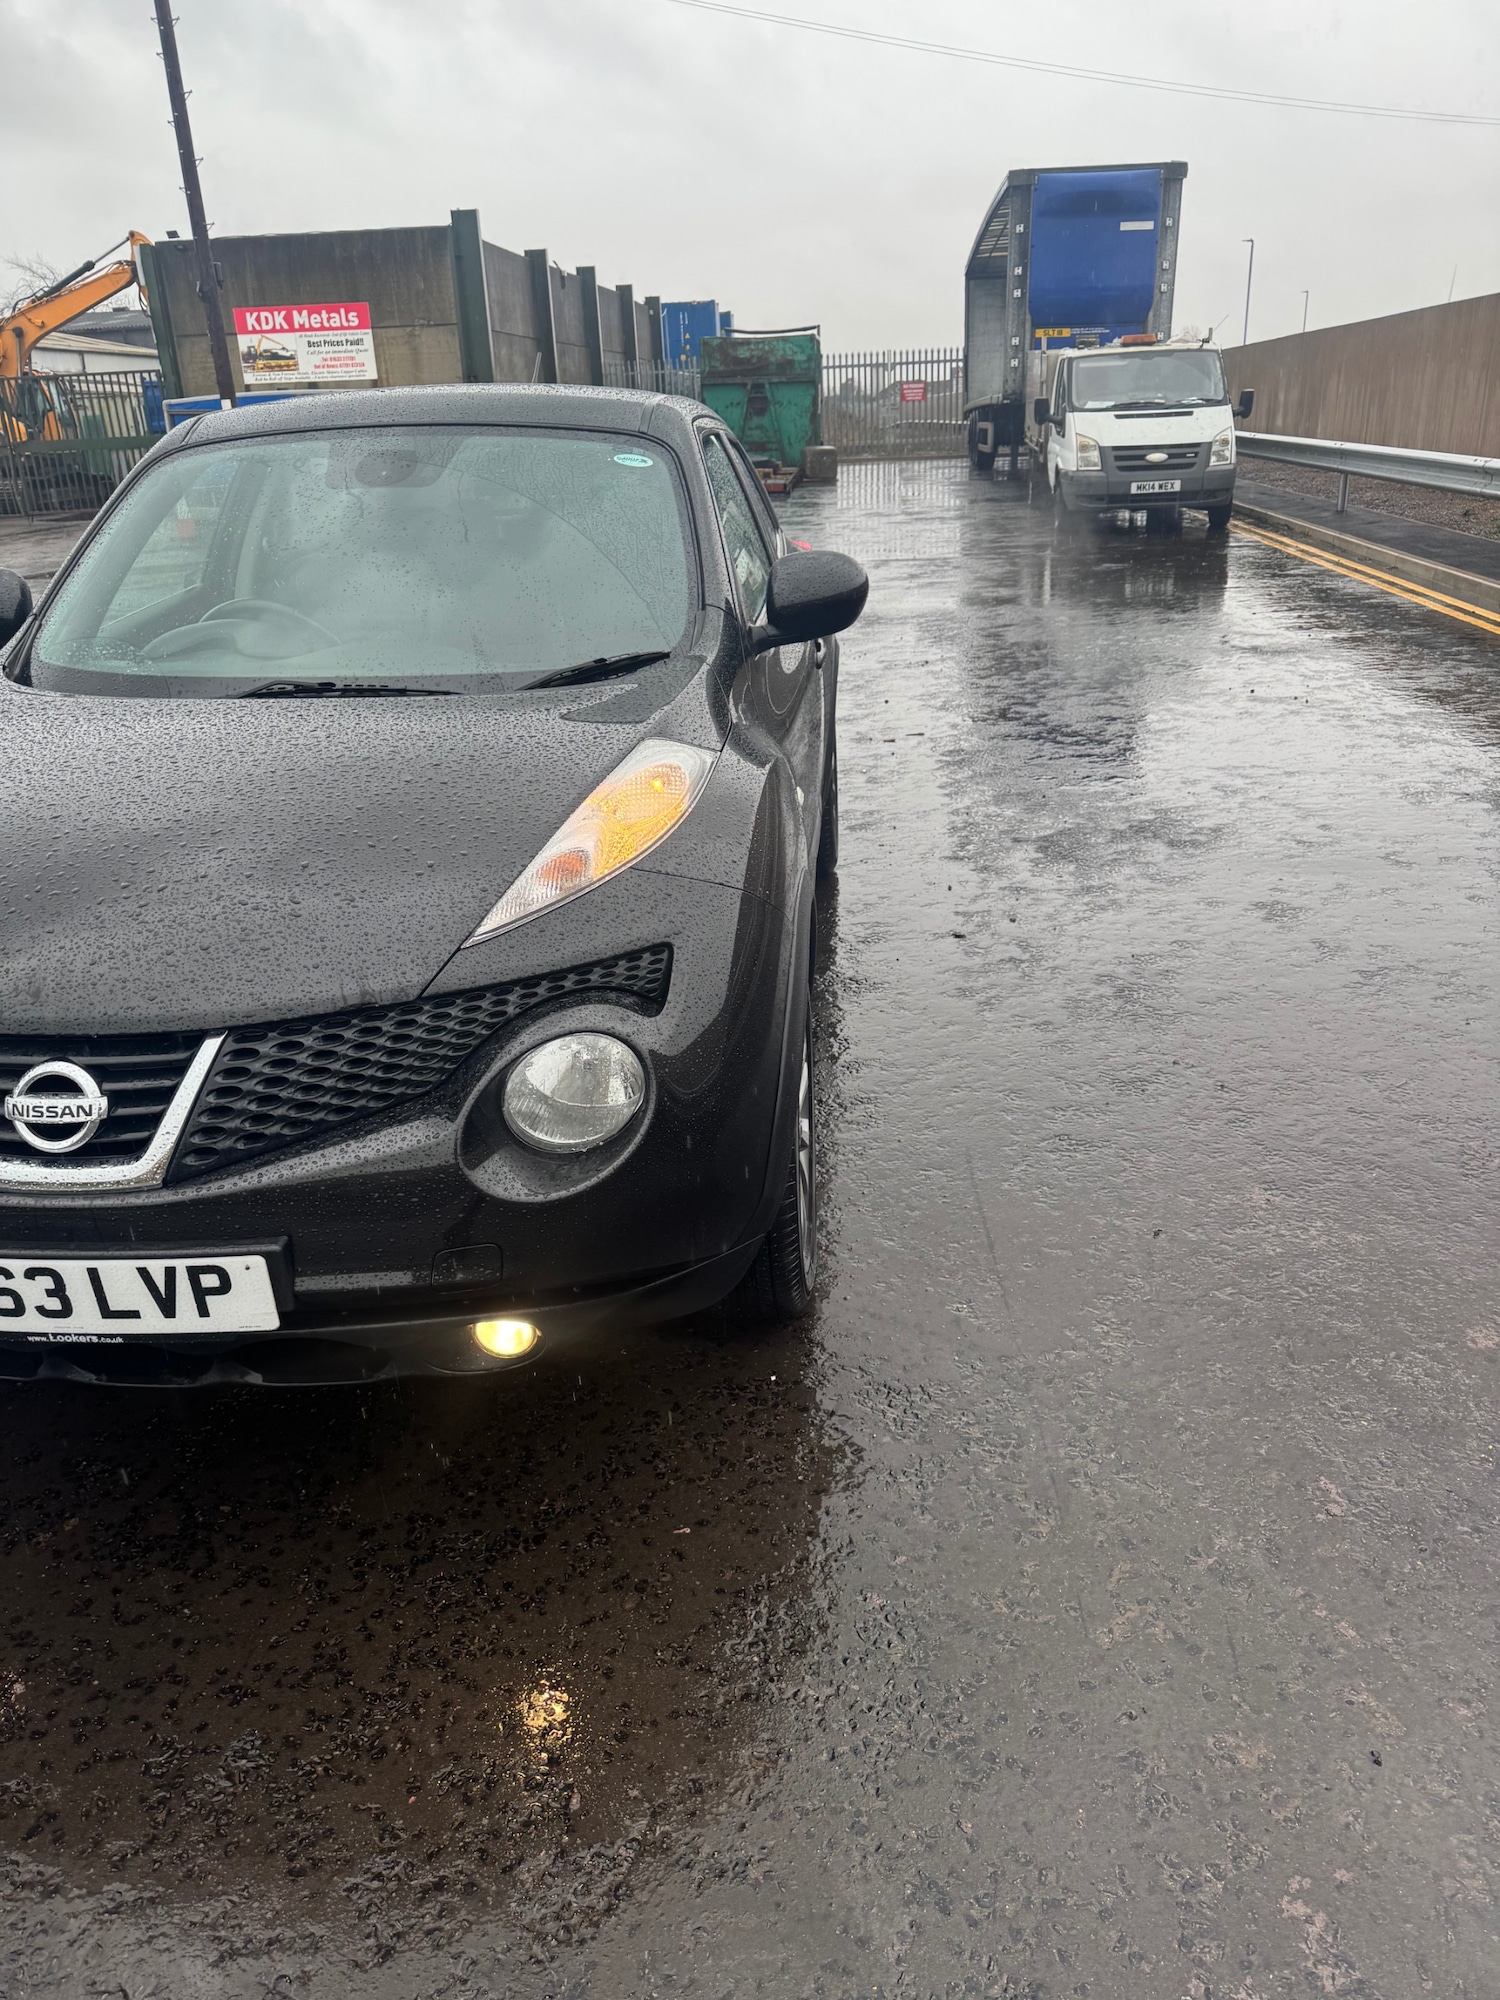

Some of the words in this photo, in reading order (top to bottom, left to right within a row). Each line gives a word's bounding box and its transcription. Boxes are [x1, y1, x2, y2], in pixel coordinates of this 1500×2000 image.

[245, 310, 290, 331] KDK
[292, 307, 359, 329] Metals
[307, 339, 323, 348] Best
[323, 338, 344, 347] Prices
[345, 337, 364, 346] Paid!!
[12, 1103, 93, 1119] NISSAN
[86, 1264, 231, 1319] LVP
